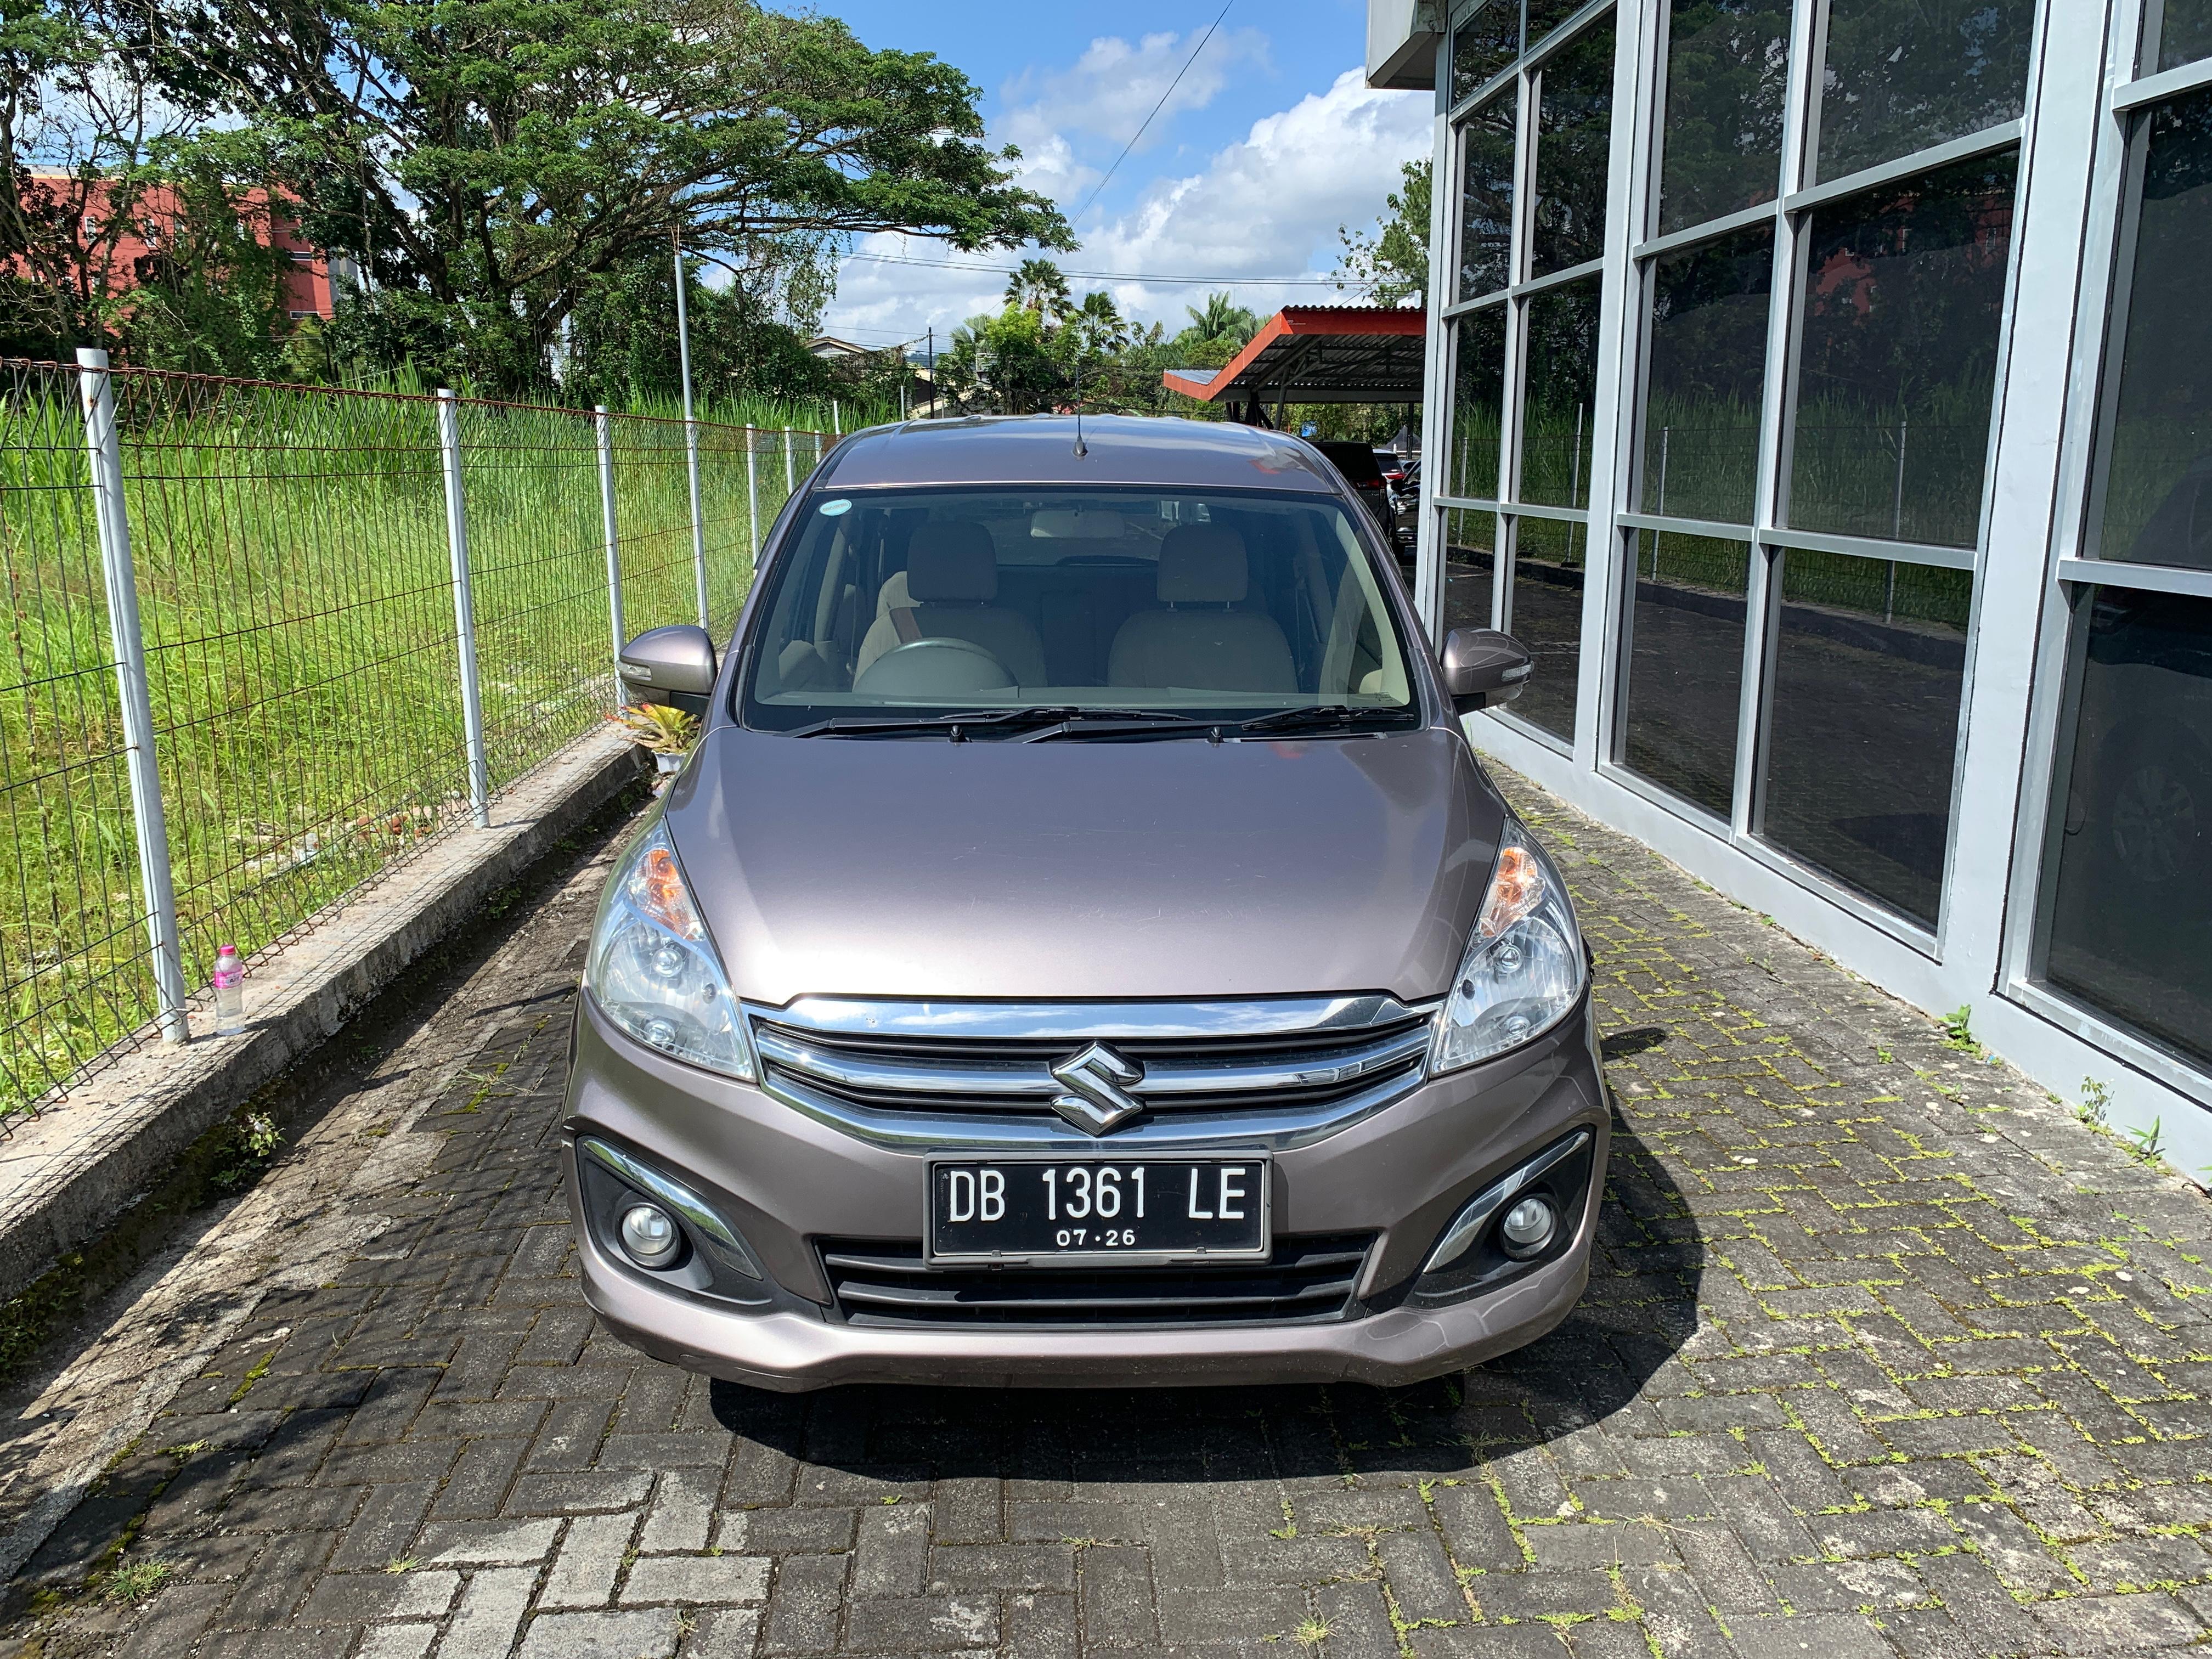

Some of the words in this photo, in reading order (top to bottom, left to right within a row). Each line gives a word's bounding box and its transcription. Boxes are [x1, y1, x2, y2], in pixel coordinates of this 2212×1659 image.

[950, 1170, 1005, 1222] DB
[1042, 1167, 1145, 1220] 1361
[1189, 1168, 1246, 1219] LE
